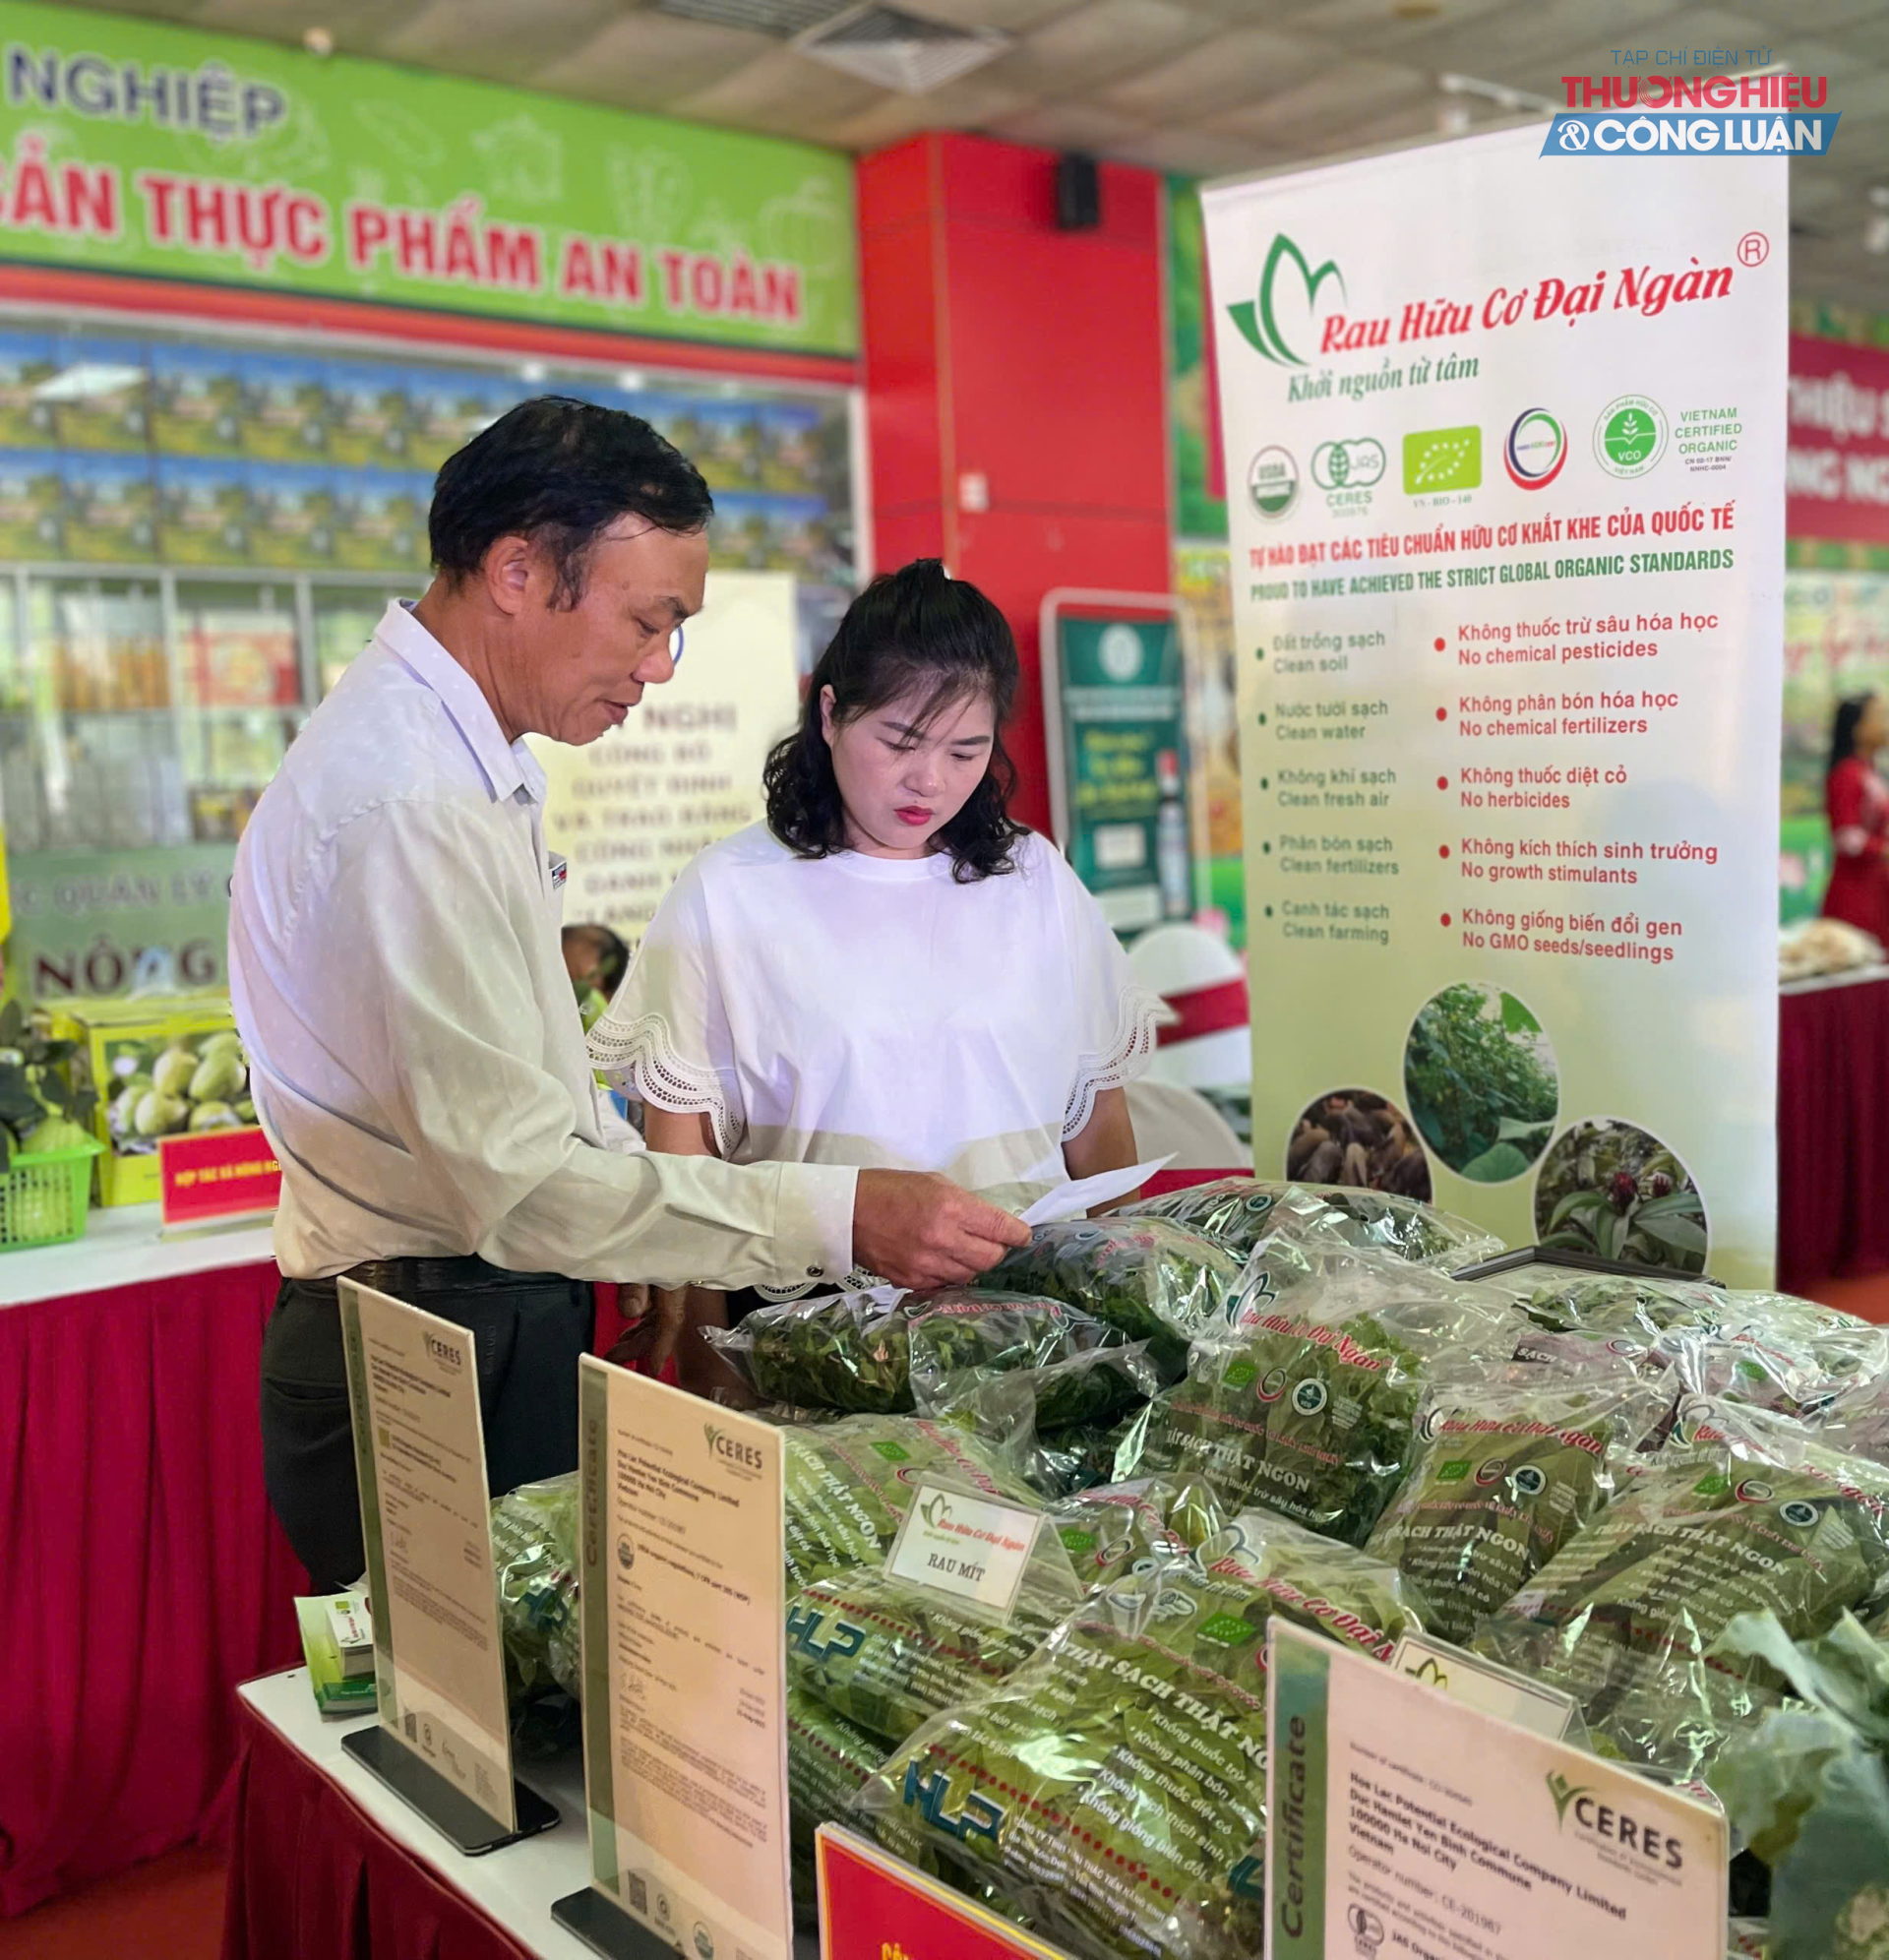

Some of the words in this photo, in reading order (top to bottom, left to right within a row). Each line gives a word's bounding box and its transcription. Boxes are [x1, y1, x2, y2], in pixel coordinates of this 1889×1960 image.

[10, 51, 285, 141] NGHIỆP
[0, 136, 116, 234] ẢN
[143, 175, 327, 269] THỰC
[562, 241, 639, 305] AN
[659, 246, 801, 321] TOÀN
[1321, 314, 1390, 352] Rau
[1399, 297, 1472, 342] Hữu
[1482, 287, 1529, 329] Cơ
[1533, 271, 1607, 327] Đại
[1614, 258, 1734, 316] Ngàn
[1288, 368, 1331, 401] Khởi
[1338, 357, 1403, 400] nguồn
[1410, 355, 1431, 383] từ
[1436, 352, 1480, 379] tâm
[1680, 407, 1737, 421] VIETNAM
[1675, 424, 1742, 439] CERTIFIED
[1618, 450, 1641, 460] VCO
[1678, 440, 1737, 455] ORGANIC
[1326, 491, 1372, 507] CERES
[1299, 542, 1326, 569] ĐẠT
[1331, 536, 1363, 561] CÁC
[1368, 532, 1399, 559] TIÊU
[1404, 522, 1456, 556] CHUẨN
[1461, 523, 1493, 549] HỮU
[1497, 522, 1518, 547] CƠ
[1522, 512, 1562, 544] KHẮT
[1567, 517, 1601, 540] KHE
[1608, 506, 1645, 537] CỦA
[1651, 501, 1704, 536] QUỐC
[1711, 499, 1736, 529] TẾ
[1250, 582, 1289, 601] PROUD
[1293, 582, 1308, 598] TO
[1311, 578, 1345, 597] HAVE
[1350, 573, 1414, 595] ACHIEVED
[1418, 570, 1442, 589] THE
[1447, 566, 1495, 587] STRICT
[1499, 561, 1551, 584] GLOBAL
[1554, 554, 1624, 580] ORGANIC
[1629, 548, 1735, 574] STANDARDS
[1348, 630, 1385, 649] sạch
[1458, 623, 1511, 643] Không
[1516, 617, 1560, 638] thuốc
[1566, 616, 1591, 635] trừ
[1596, 616, 1630, 634] sâu
[1636, 614, 1673, 632] hóa
[1680, 613, 1719, 633] học
[1319, 655, 1348, 672] soil
[1458, 649, 1482, 666] No
[1486, 644, 1556, 664] chemical
[1561, 641, 1659, 664] pesticides
[1351, 700, 1388, 719] sạch
[1459, 696, 1512, 716] Không
[1517, 693, 1555, 715] phân
[1561, 691, 1594, 710] bón
[1601, 691, 1635, 708] hóa
[1642, 691, 1678, 711] học
[1276, 724, 1317, 741] Clean
[1322, 724, 1366, 739] water
[1459, 720, 1482, 737] No
[1487, 718, 1557, 736] chemical
[1561, 717, 1648, 735] fertilizers
[1278, 768, 1326, 787] Không
[1361, 767, 1396, 785] sạch
[1461, 766, 1513, 787] Không
[1518, 765, 1561, 784] thuốc
[1566, 767, 1599, 787] diệt
[1605, 765, 1627, 784] cỏ
[1278, 791, 1319, 807] Clean
[1324, 791, 1365, 807] fresh
[1370, 792, 1389, 807] air
[1460, 791, 1483, 808] No
[1488, 791, 1570, 808] herbicides
[1279, 834, 1316, 850] Phân
[1321, 835, 1351, 851] bón
[1357, 836, 1392, 854] sạch
[1461, 838, 1514, 859] Không
[1519, 839, 1552, 857] kích
[1555, 839, 1598, 858] thích
[1604, 842, 1643, 859] sinh
[1650, 841, 1718, 865] trưởng
[1280, 857, 1321, 873] Clean
[1326, 858, 1399, 875] fertilizers
[1461, 862, 1484, 878] No
[1489, 863, 1543, 882] growth
[1548, 866, 1638, 884] stimulants
[1282, 900, 1320, 916] Canh
[1324, 901, 1349, 917] tác
[1354, 903, 1389, 920] sạch
[1462, 908, 1515, 930] Không
[1520, 909, 1564, 934] giống
[1569, 913, 1605, 933] biến
[1611, 912, 1639, 934] đổi
[1646, 922, 1682, 939] gen
[1282, 922, 1324, 938] Clean
[1329, 924, 1389, 946] farming
[1462, 932, 1485, 948] No
[1490, 933, 1529, 950] GMO
[1534, 939, 1675, 964] seeds/seedlings
[34, 933, 217, 996] NÔG
[431, 1339, 461, 1366] CERES
[715, 1436, 762, 1469] CERES
[1257, 1460, 1310, 1493] NGON
[845, 1502, 882, 1550] NGON
[1475, 1526, 1531, 1562] NGON
[1730, 1541, 1792, 1576] NGON
[928, 1553, 957, 1574] RAU
[957, 1561, 986, 1582] MÍT
[1112, 1659, 1171, 1700] SẠCH
[1173, 1692, 1240, 1741] THẬT
[1117, 1748, 1155, 1780] Không
[1281, 1715, 1306, 1938] Certificate
[1349, 1821, 1394, 1856] Vietnam
[1350, 1806, 1391, 1836] 100000
[1393, 1828, 1410, 1846] Ha
[1412, 1838, 1432, 1857] Noi
[1433, 1848, 1458, 1872] City
[1350, 1788, 1371, 1808] Duc
[1373, 1800, 1413, 1830] Hamlet
[1417, 1821, 1437, 1841] Yen
[1440, 1835, 1468, 1859] Binh
[1470, 1851, 1532, 1892] Commune
[1574, 1796, 1683, 1869] CERES
[1348, 1844, 1391, 1875] Operator
[1350, 1771, 1371, 1791] Hoa
[1374, 1784, 1392, 1801] Lac
[1395, 1793, 1447, 1828] Potential
[1450, 1821, 1510, 1862] Ecological
[1514, 1854, 1573, 1897] Company
[1576, 1885, 1626, 1921] Limited
